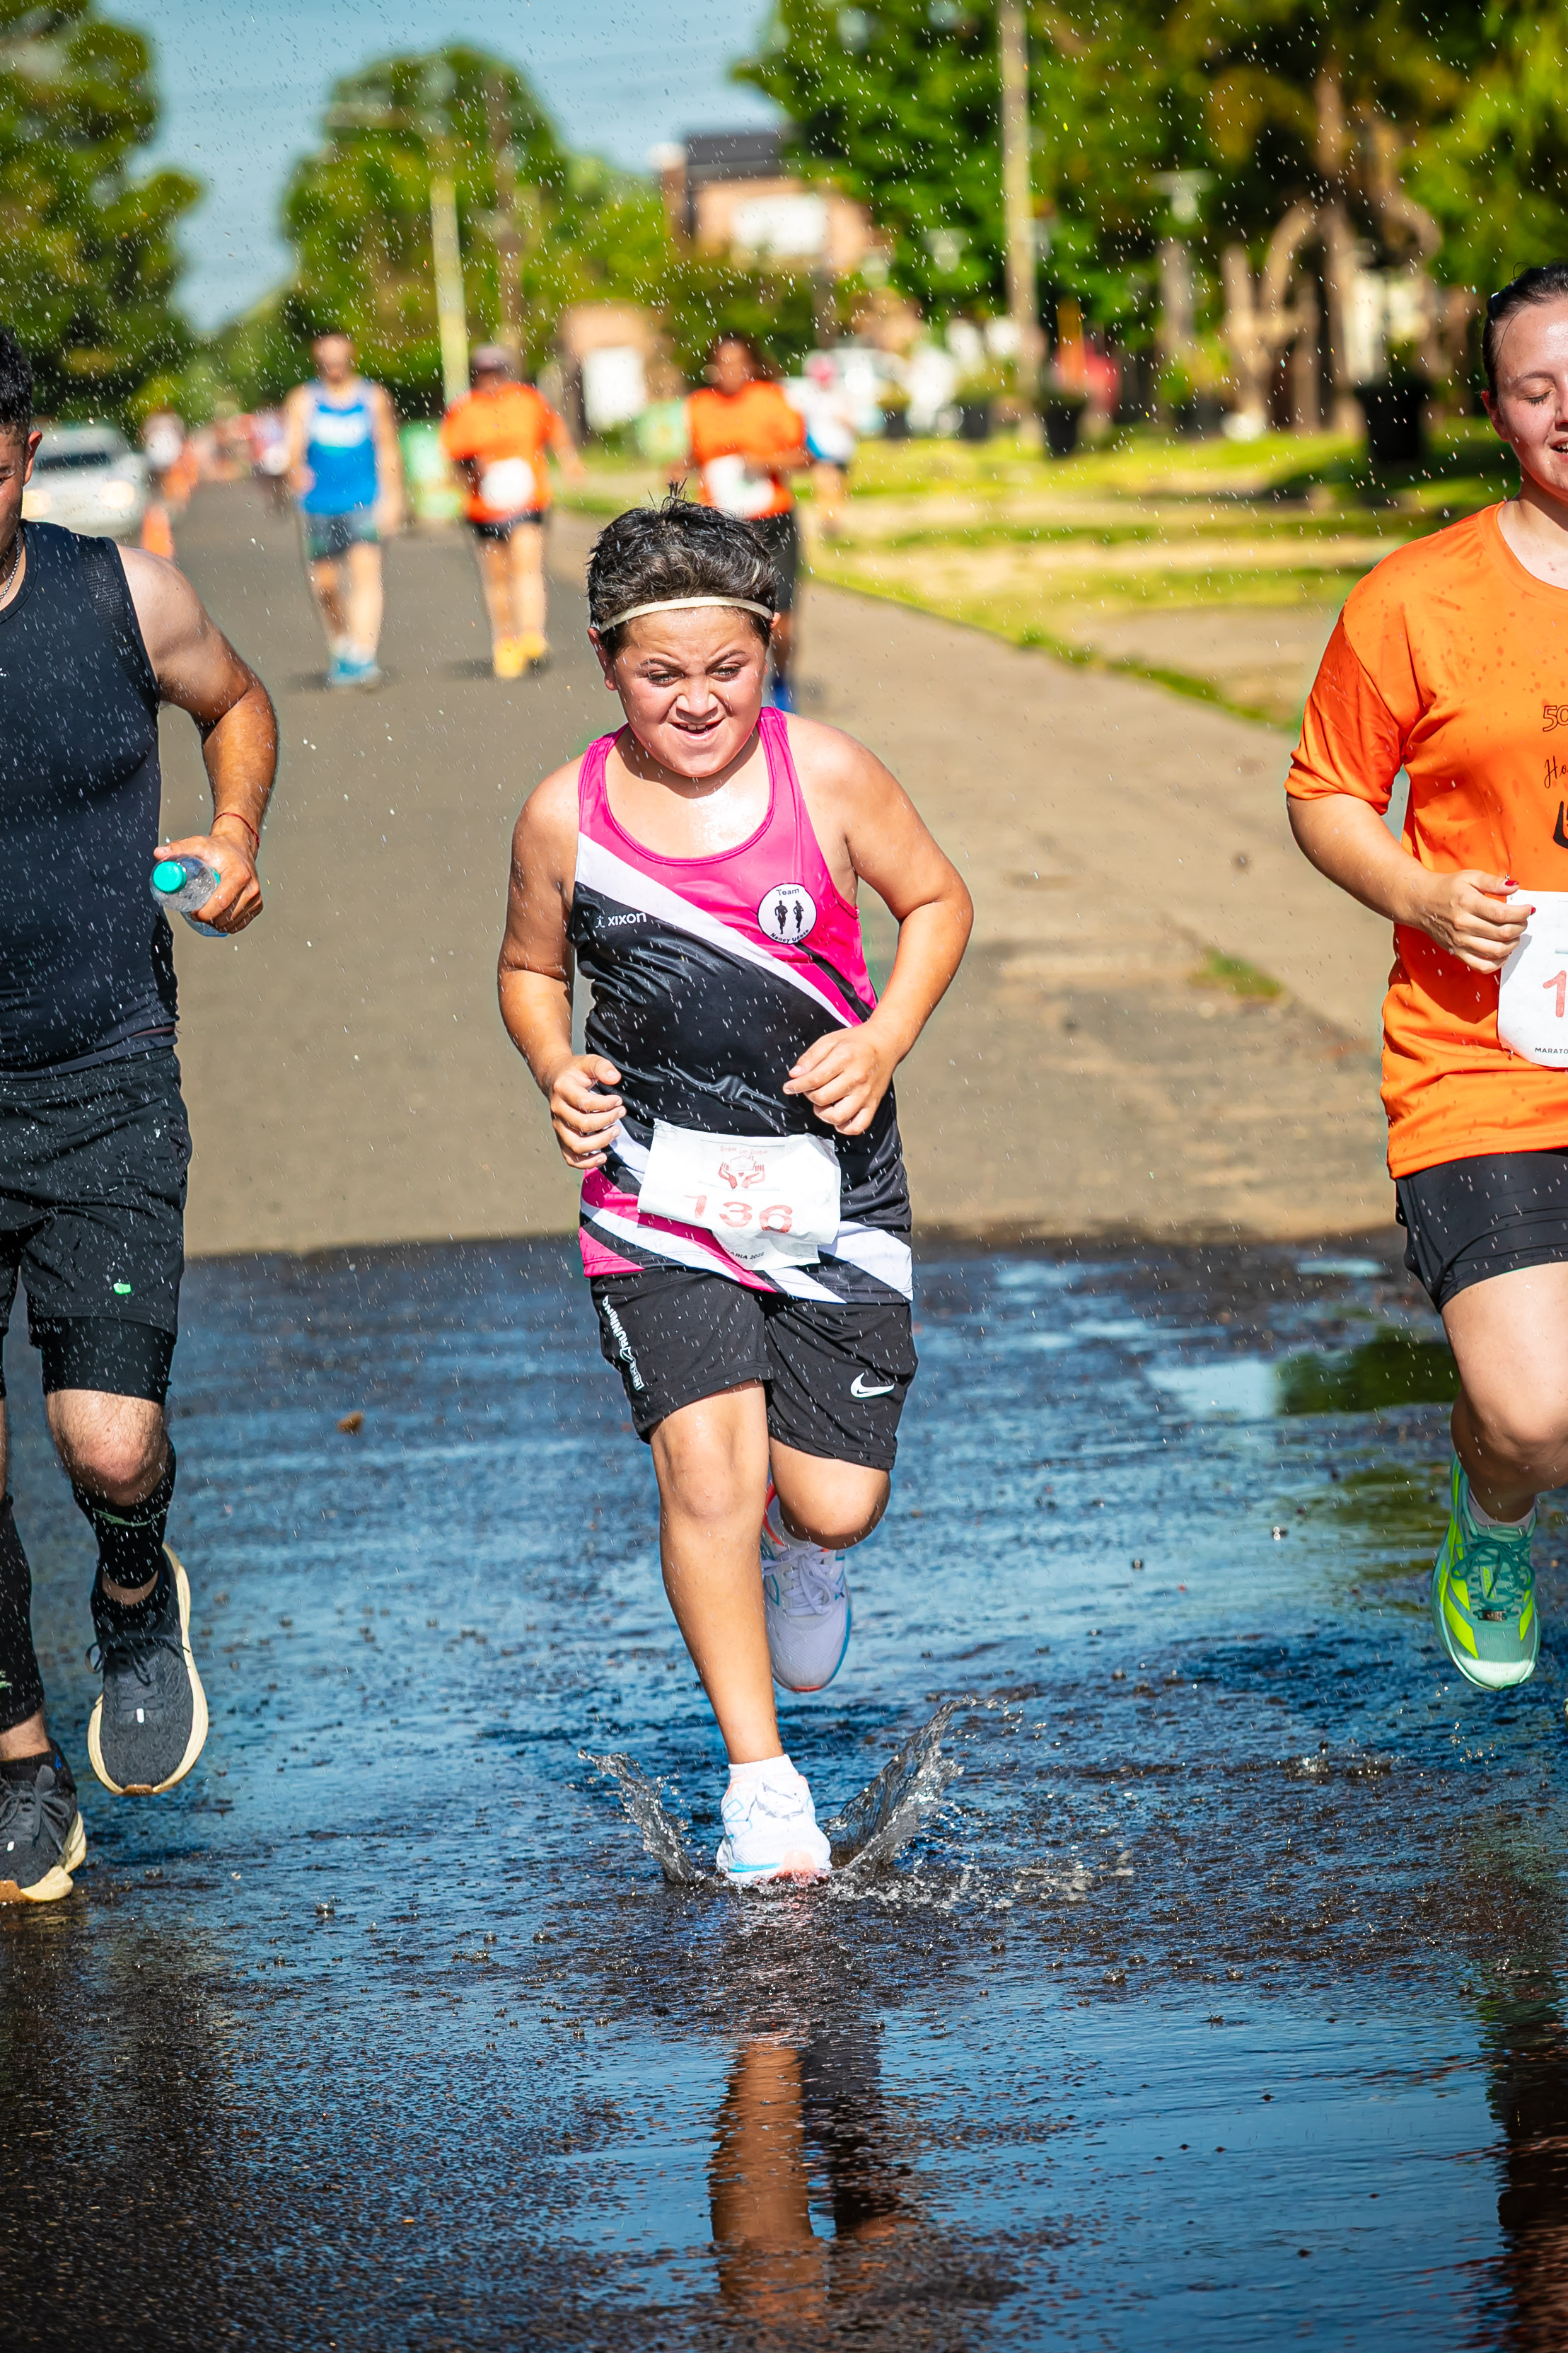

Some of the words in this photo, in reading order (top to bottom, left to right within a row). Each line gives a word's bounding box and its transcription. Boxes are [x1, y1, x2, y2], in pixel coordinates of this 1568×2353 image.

[770, 932, 790, 944] Nancy
[685, 1194, 793, 1233] 136
[749, 1251, 765, 1260] 2025
